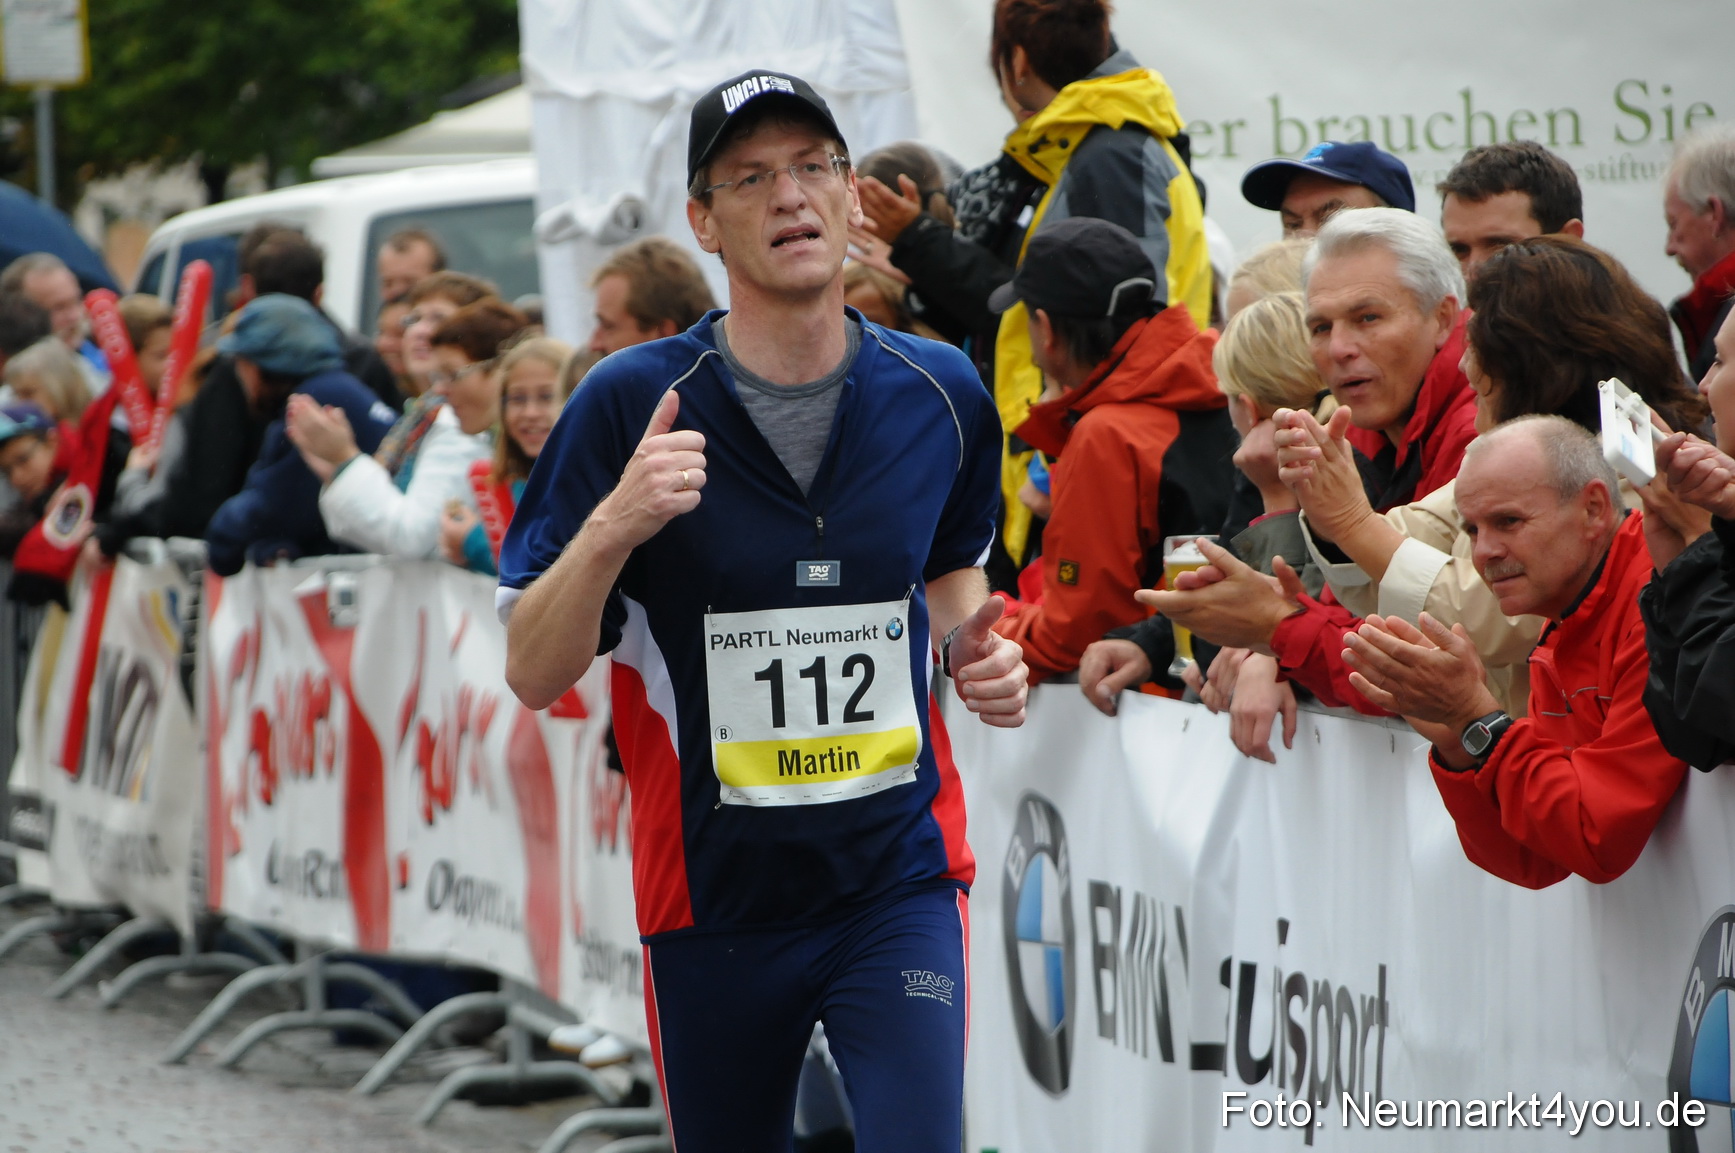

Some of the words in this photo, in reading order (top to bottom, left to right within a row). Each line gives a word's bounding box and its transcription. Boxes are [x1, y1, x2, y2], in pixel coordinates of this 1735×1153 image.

[721, 76, 771, 113] UNCLE
[1185, 118, 1246, 159] er
[1267, 84, 1585, 156] brauchen
[1613, 79, 1717, 144] Sie
[808, 565, 830, 573] TAO
[710, 631, 781, 650] PARTL
[786, 624, 878, 646] Neumarkt
[754, 653, 875, 728] 112
[719, 728, 728, 740] B
[777, 746, 861, 777] Martin
[902, 970, 953, 992] TAO
